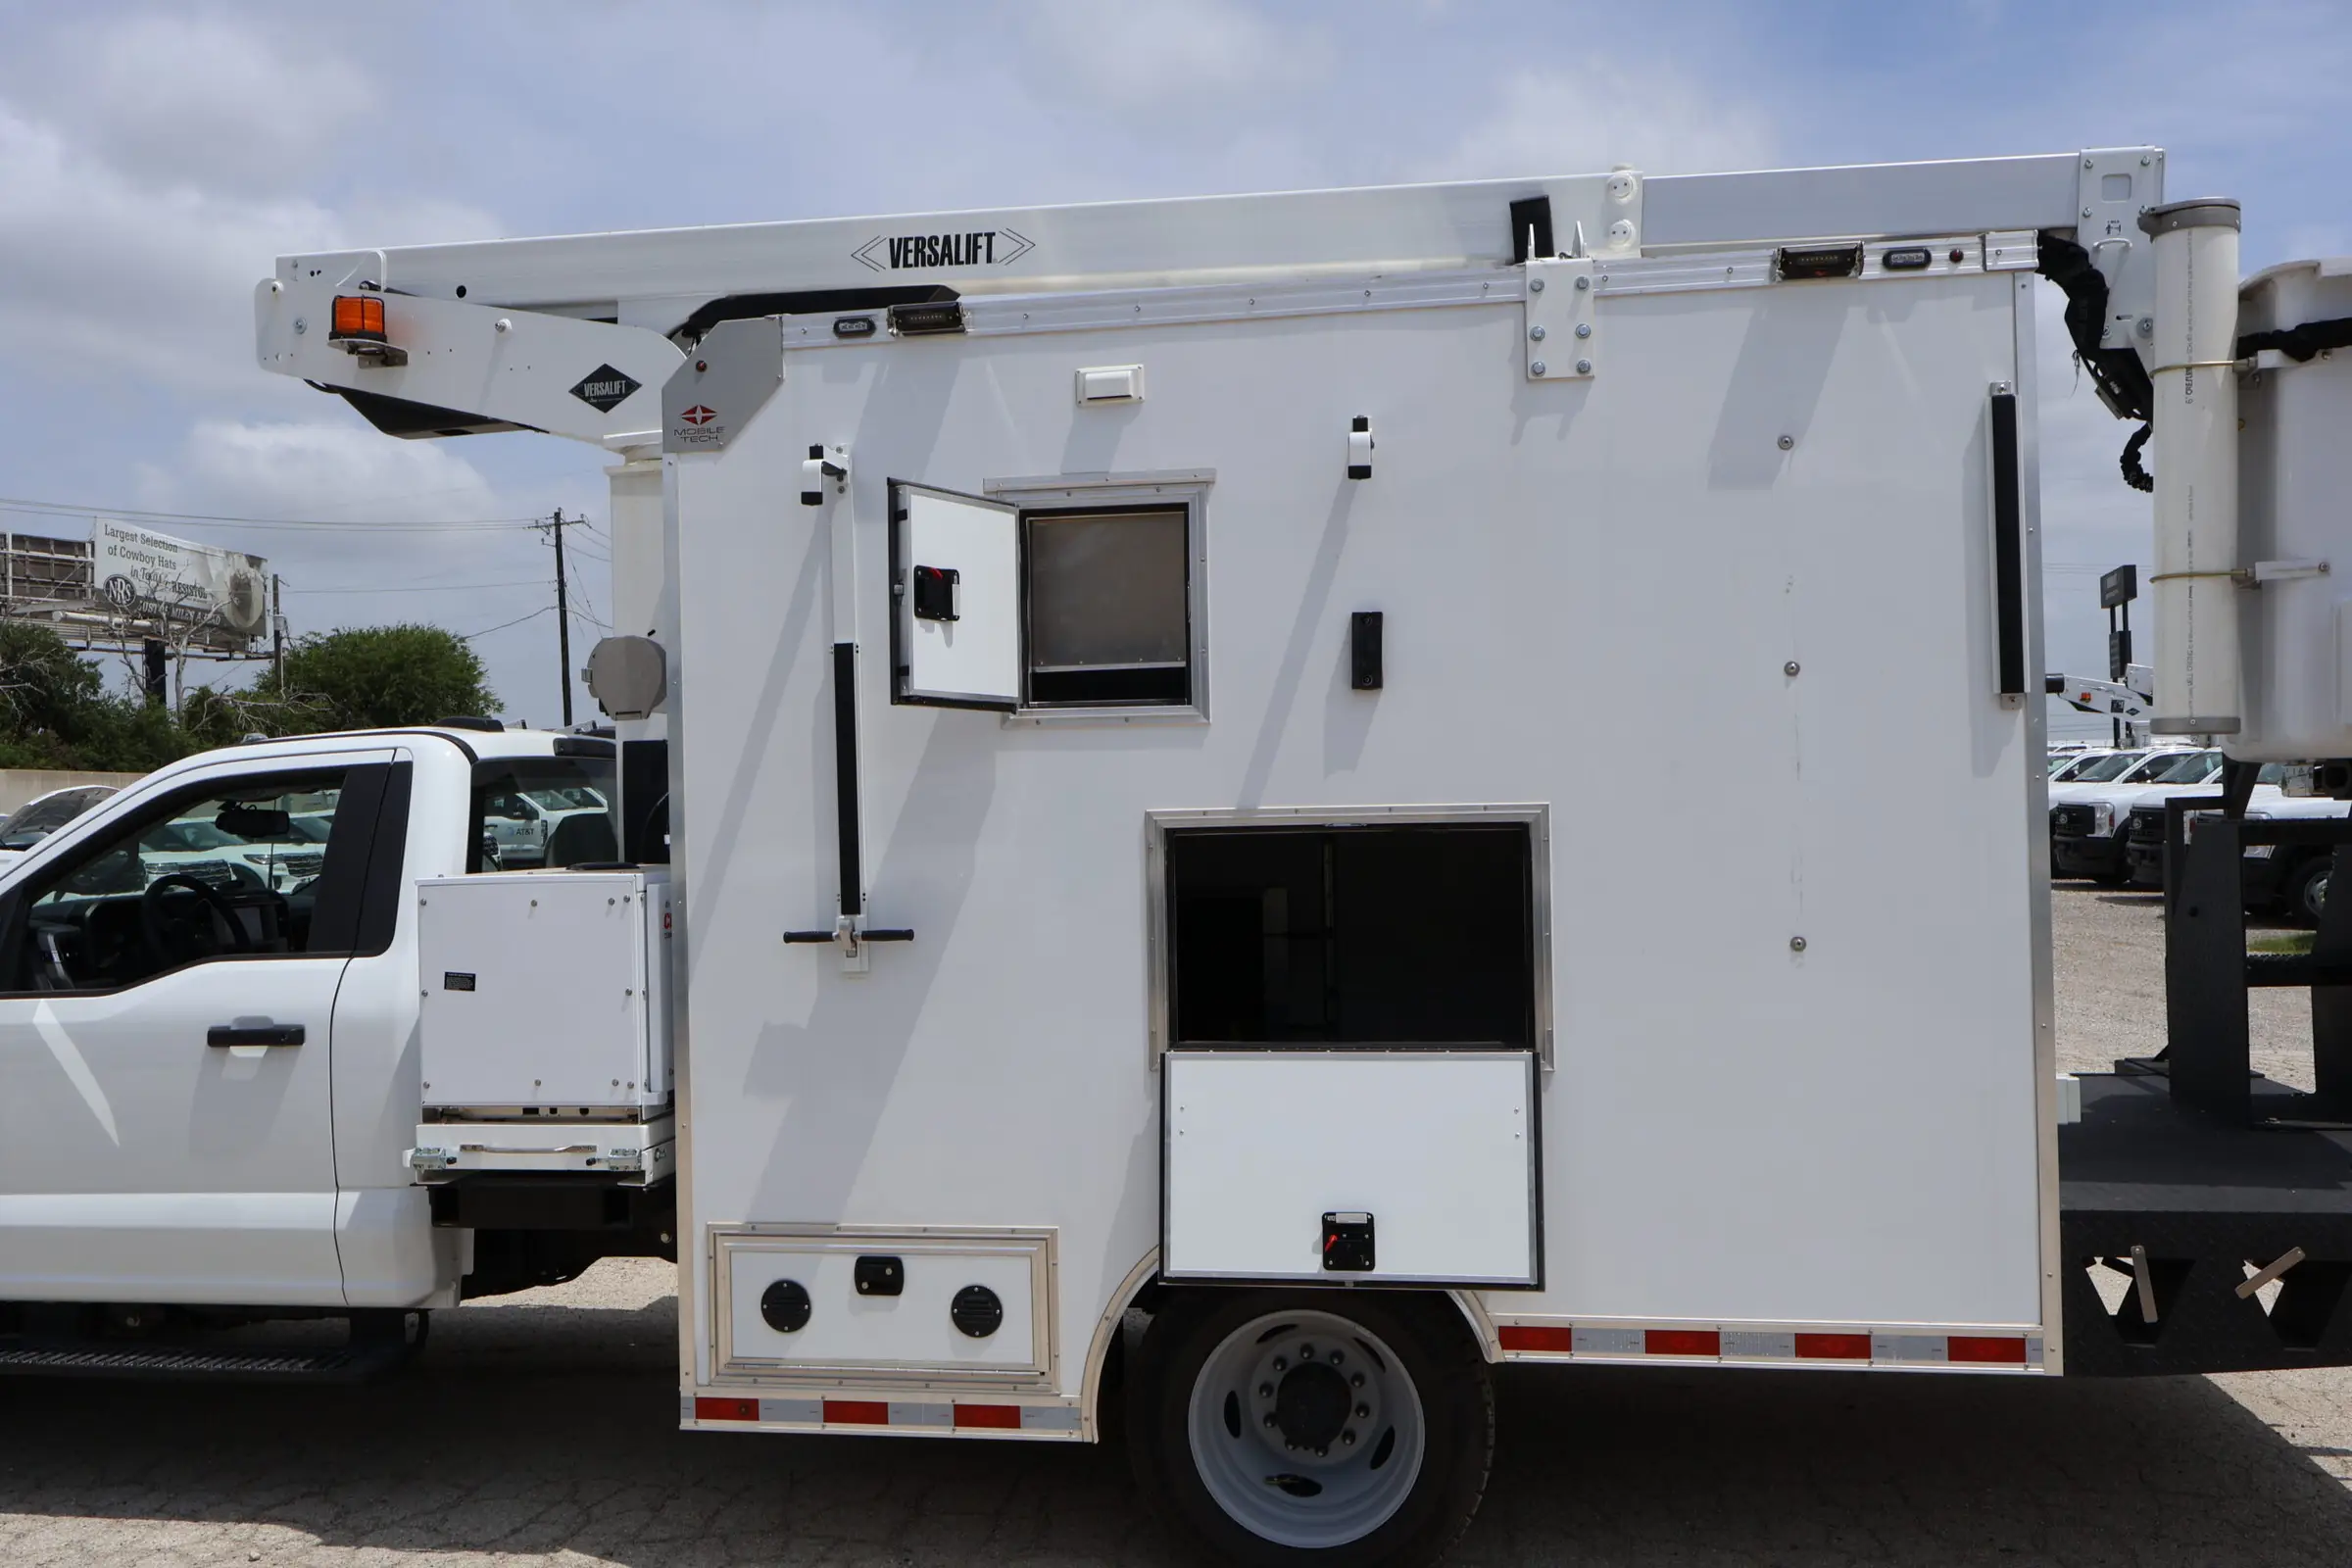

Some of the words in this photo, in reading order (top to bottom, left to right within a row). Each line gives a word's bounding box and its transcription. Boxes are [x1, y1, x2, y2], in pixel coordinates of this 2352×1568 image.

[889, 231, 996, 270] VERSALIFT
[584, 380, 626, 397] VERSALIFT
[673, 426, 726, 436] MOBILE
[105, 523, 138, 543] Largest
[140, 533, 178, 554] Selection
[108, 545, 118, 557] of
[120, 546, 156, 567] Cowboy
[158, 555, 176, 570] Hats
[130, 564, 139, 578] in
[109, 578, 131, 605] NRS
[515, 827, 535, 836] AT&T
